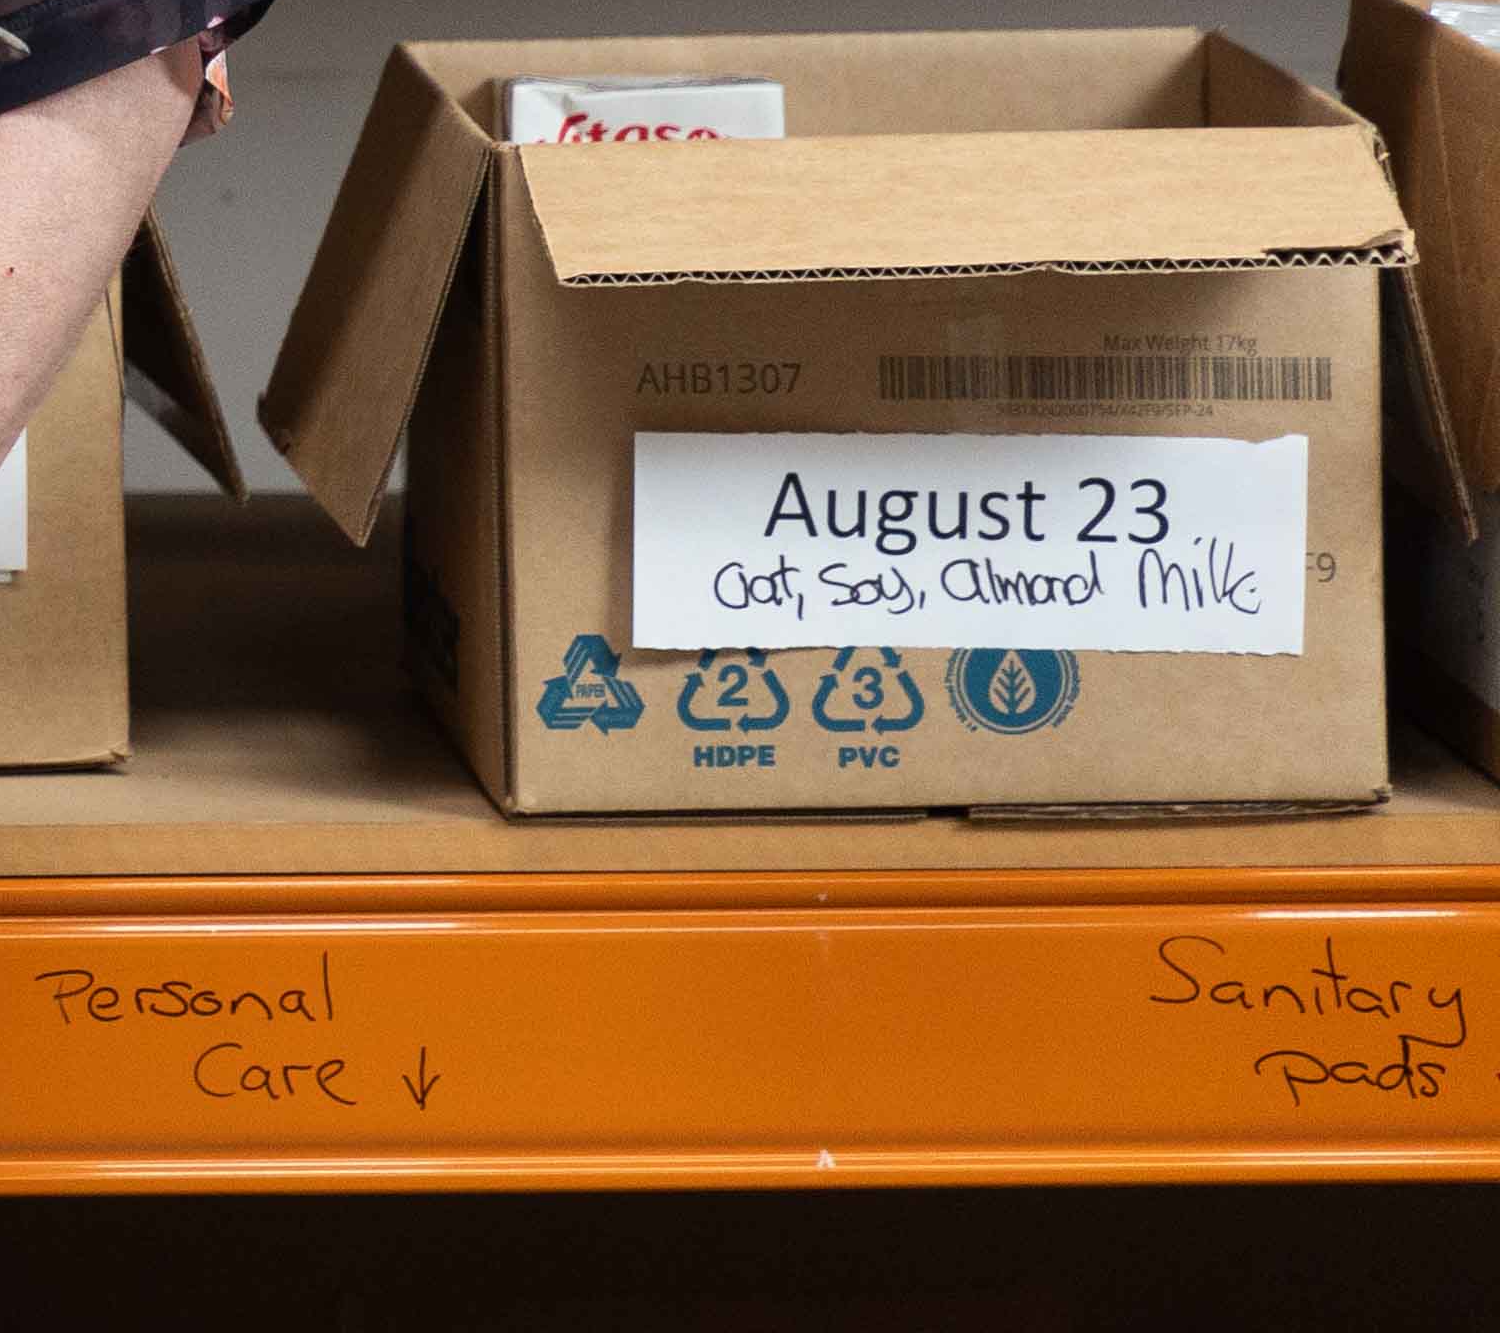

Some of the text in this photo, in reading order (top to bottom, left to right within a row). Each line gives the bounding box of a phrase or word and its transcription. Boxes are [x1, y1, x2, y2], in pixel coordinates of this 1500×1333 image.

[1104, 334, 1258, 357] Max Weight 17kg
[636, 363, 802, 395] AHB1307
[764, 471, 1170, 555] August 23
[717, 664, 885, 710] 2 3
[693, 744, 901, 768] HDPE PVC
[34, 950, 334, 1025] Personal
[1149, 935, 1467, 1049] Sanitary
[194, 1042, 358, 1106] Care
